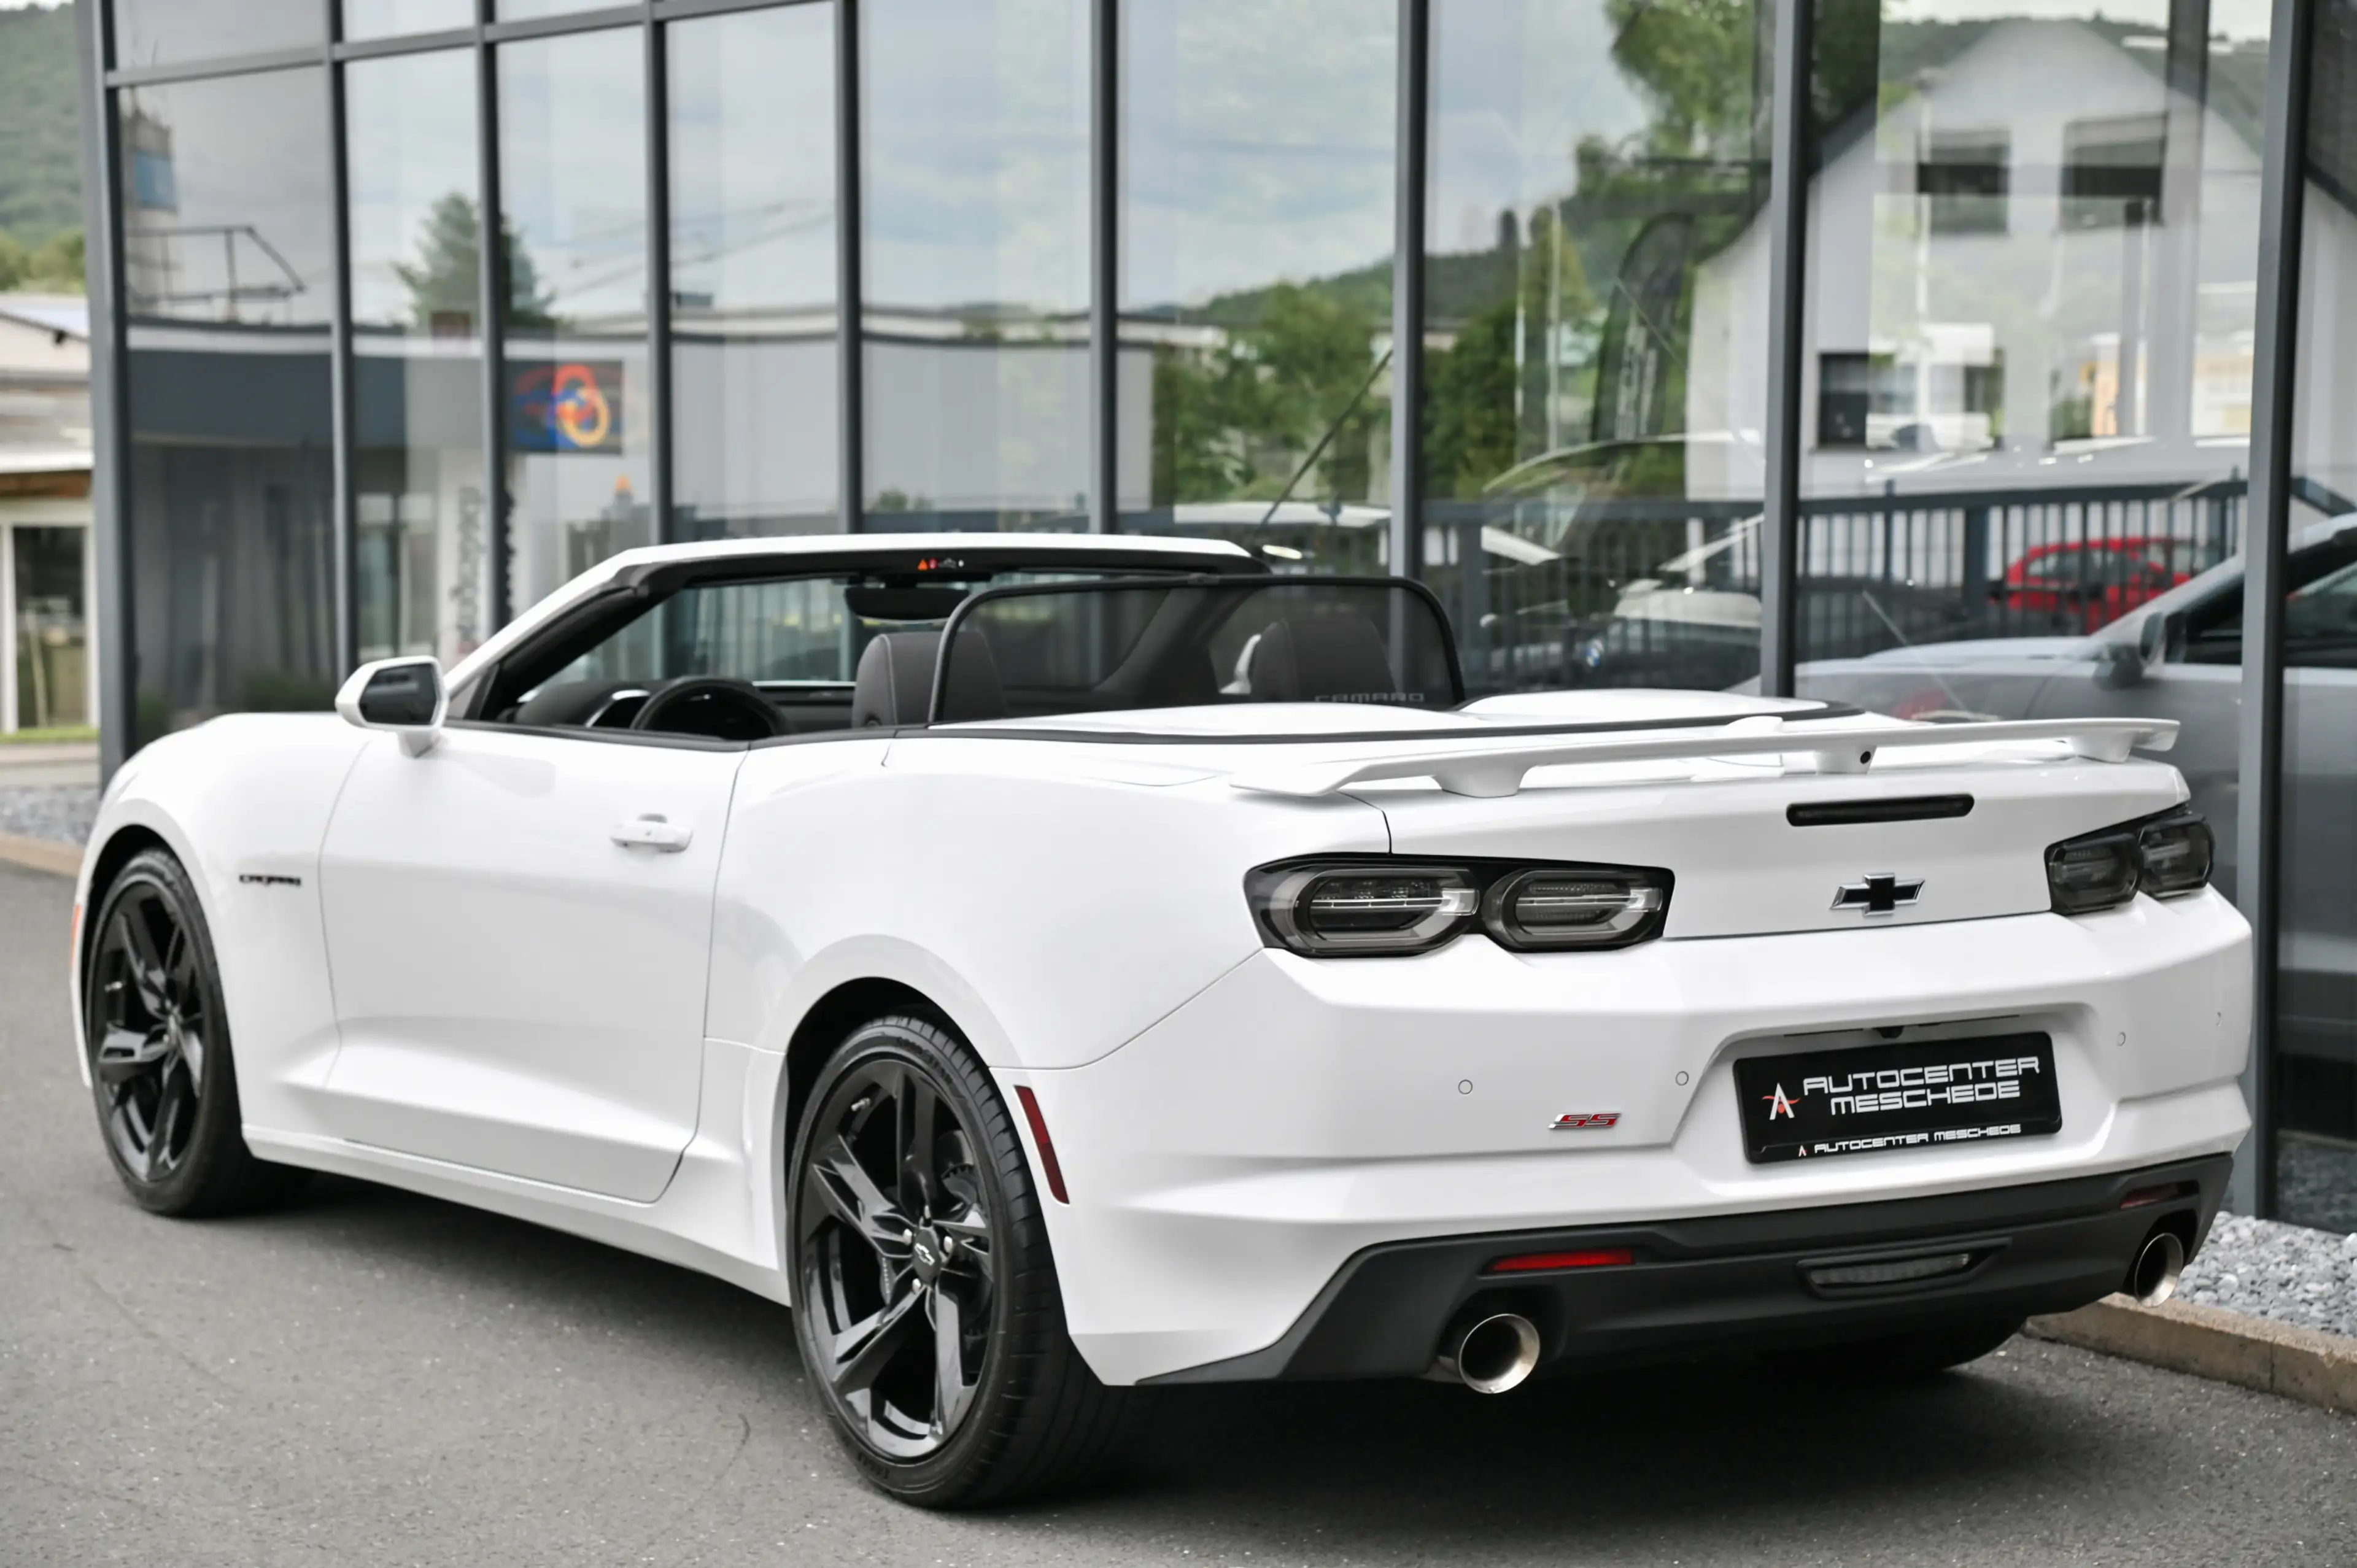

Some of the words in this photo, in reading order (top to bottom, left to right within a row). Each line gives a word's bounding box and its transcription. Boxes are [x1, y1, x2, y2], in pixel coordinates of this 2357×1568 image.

[1803, 1056, 2040, 1095] AUTOCENTER
[1830, 1079, 2020, 1116] MESCHEDE
[1547, 1112, 1622, 1129] SS
[1814, 1133, 1929, 1154] AUTOCENTER
[1933, 1124, 2021, 1141] MESCHEDE
